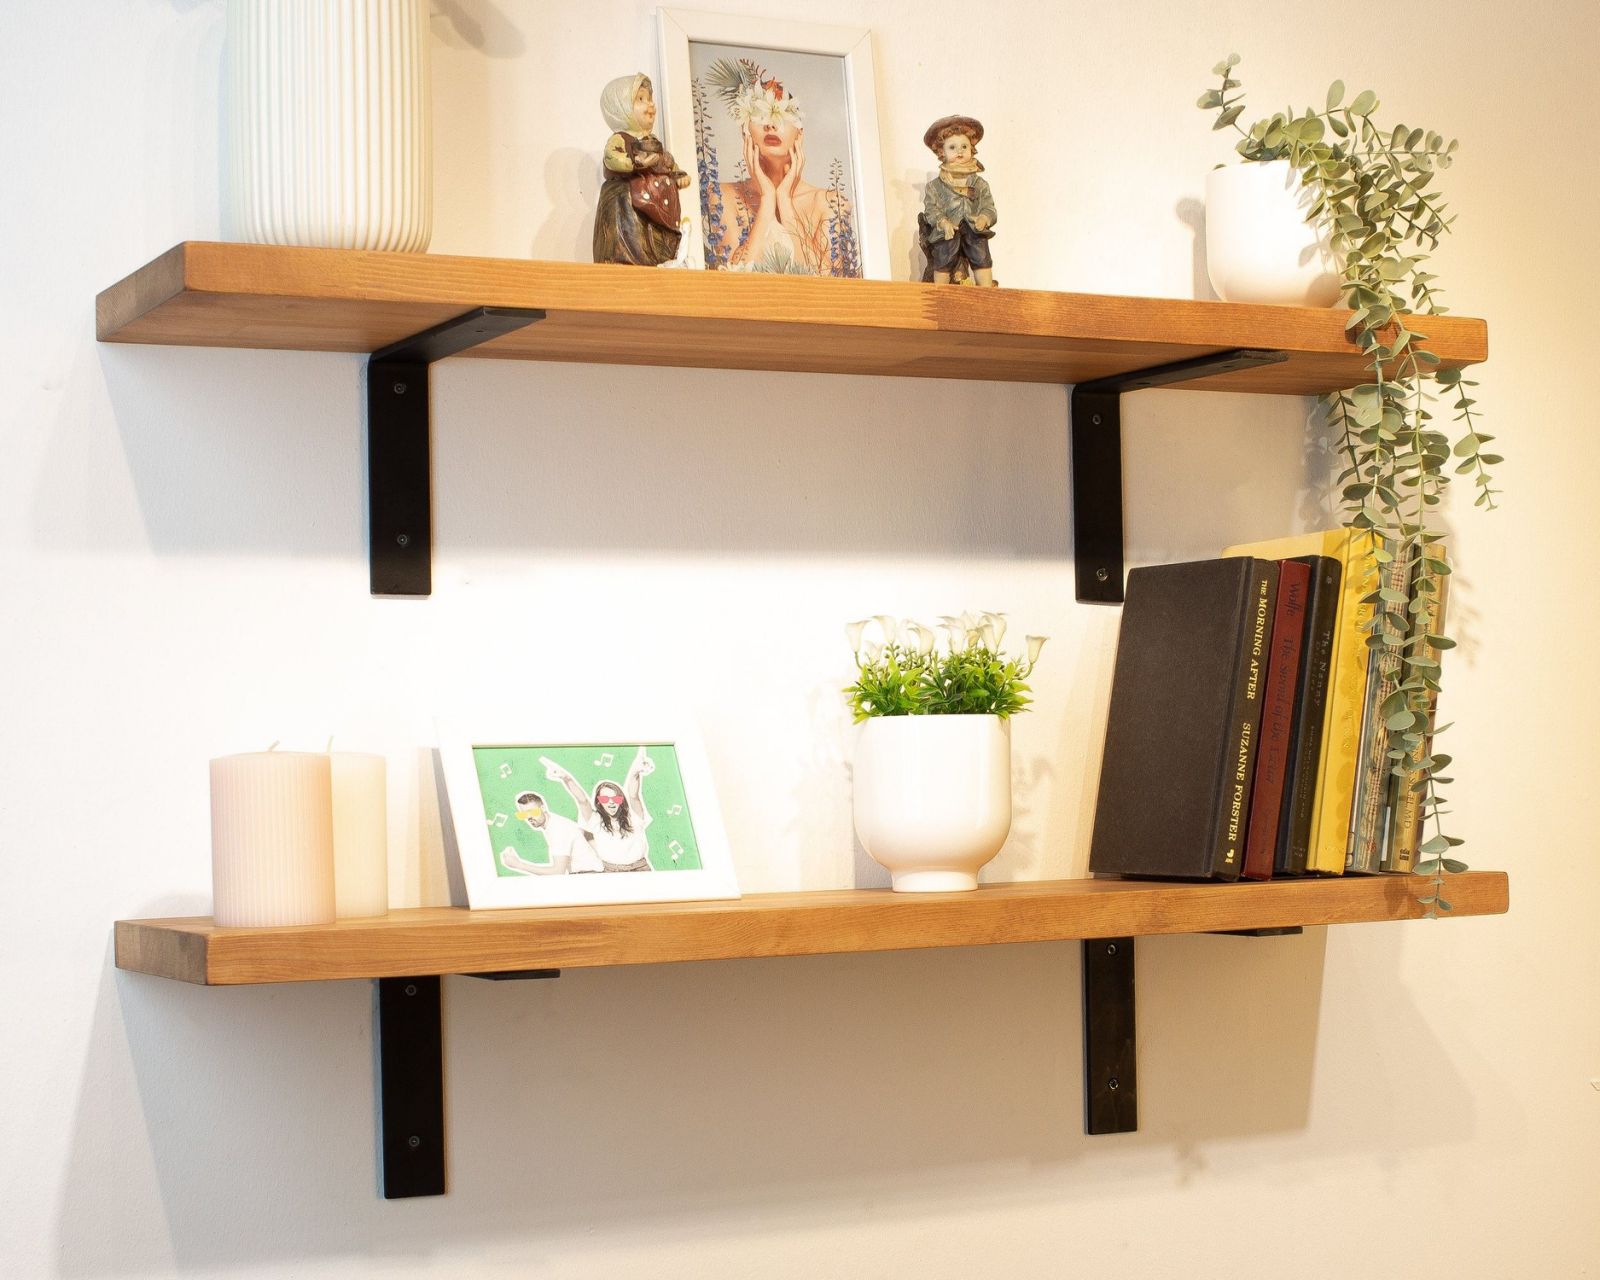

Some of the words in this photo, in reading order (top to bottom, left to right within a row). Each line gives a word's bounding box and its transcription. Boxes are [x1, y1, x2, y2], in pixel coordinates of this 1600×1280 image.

[1260, 580, 1268, 595] THE
[1287, 583, 1301, 617] Wolfe
[1252, 598, 1267, 656] MORNING
[1246, 659, 1260, 700] AFTER
[1236, 722, 1251, 781] SUZANNE
[1228, 784, 1244, 841] FORSTER
